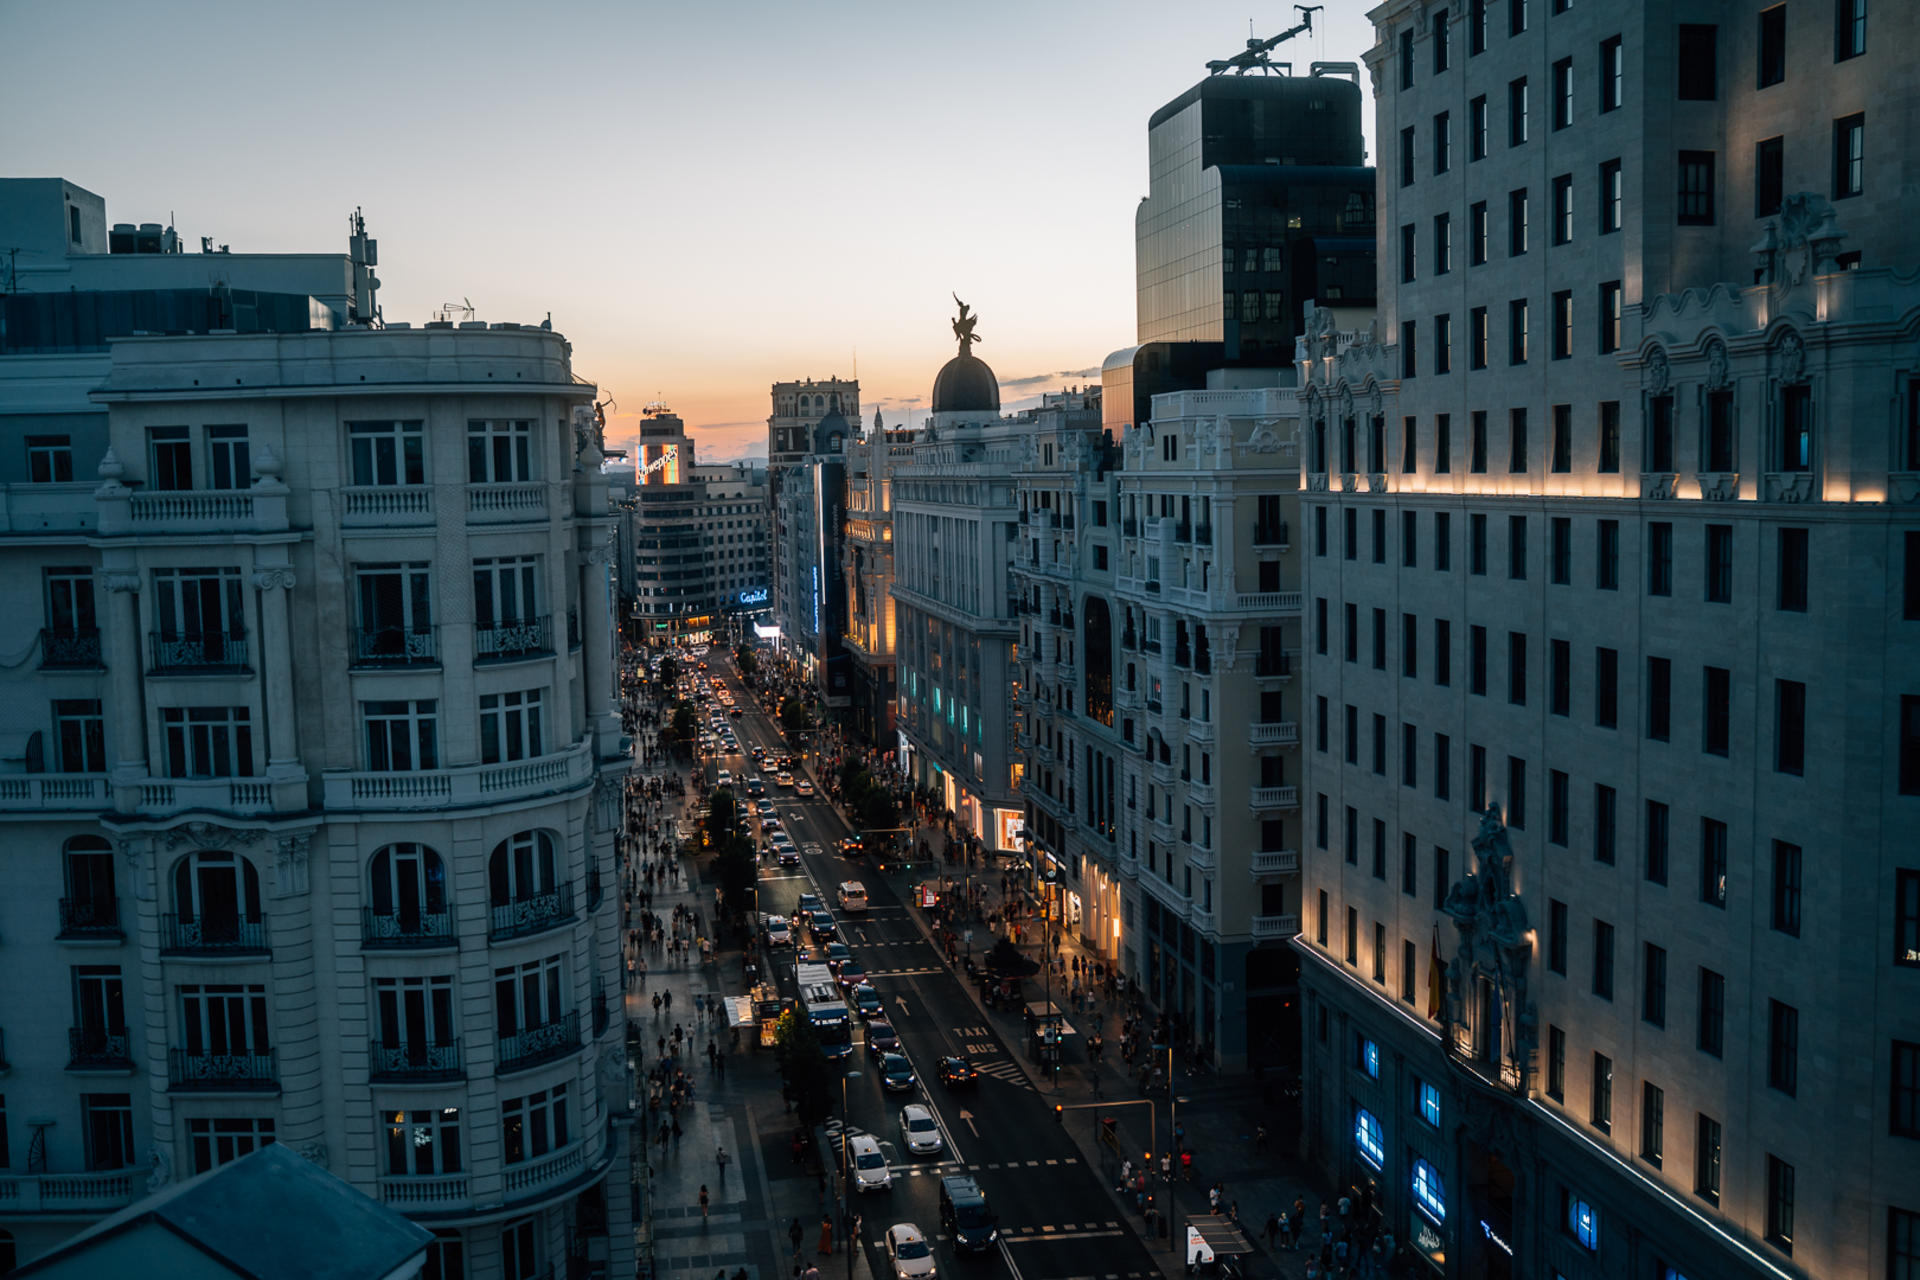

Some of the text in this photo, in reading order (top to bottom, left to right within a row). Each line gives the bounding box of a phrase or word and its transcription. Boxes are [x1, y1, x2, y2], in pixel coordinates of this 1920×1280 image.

[740, 588, 768, 604] Capitol
[952, 1026, 989, 1038] TAXI
[965, 1043, 999, 1054] BUS
